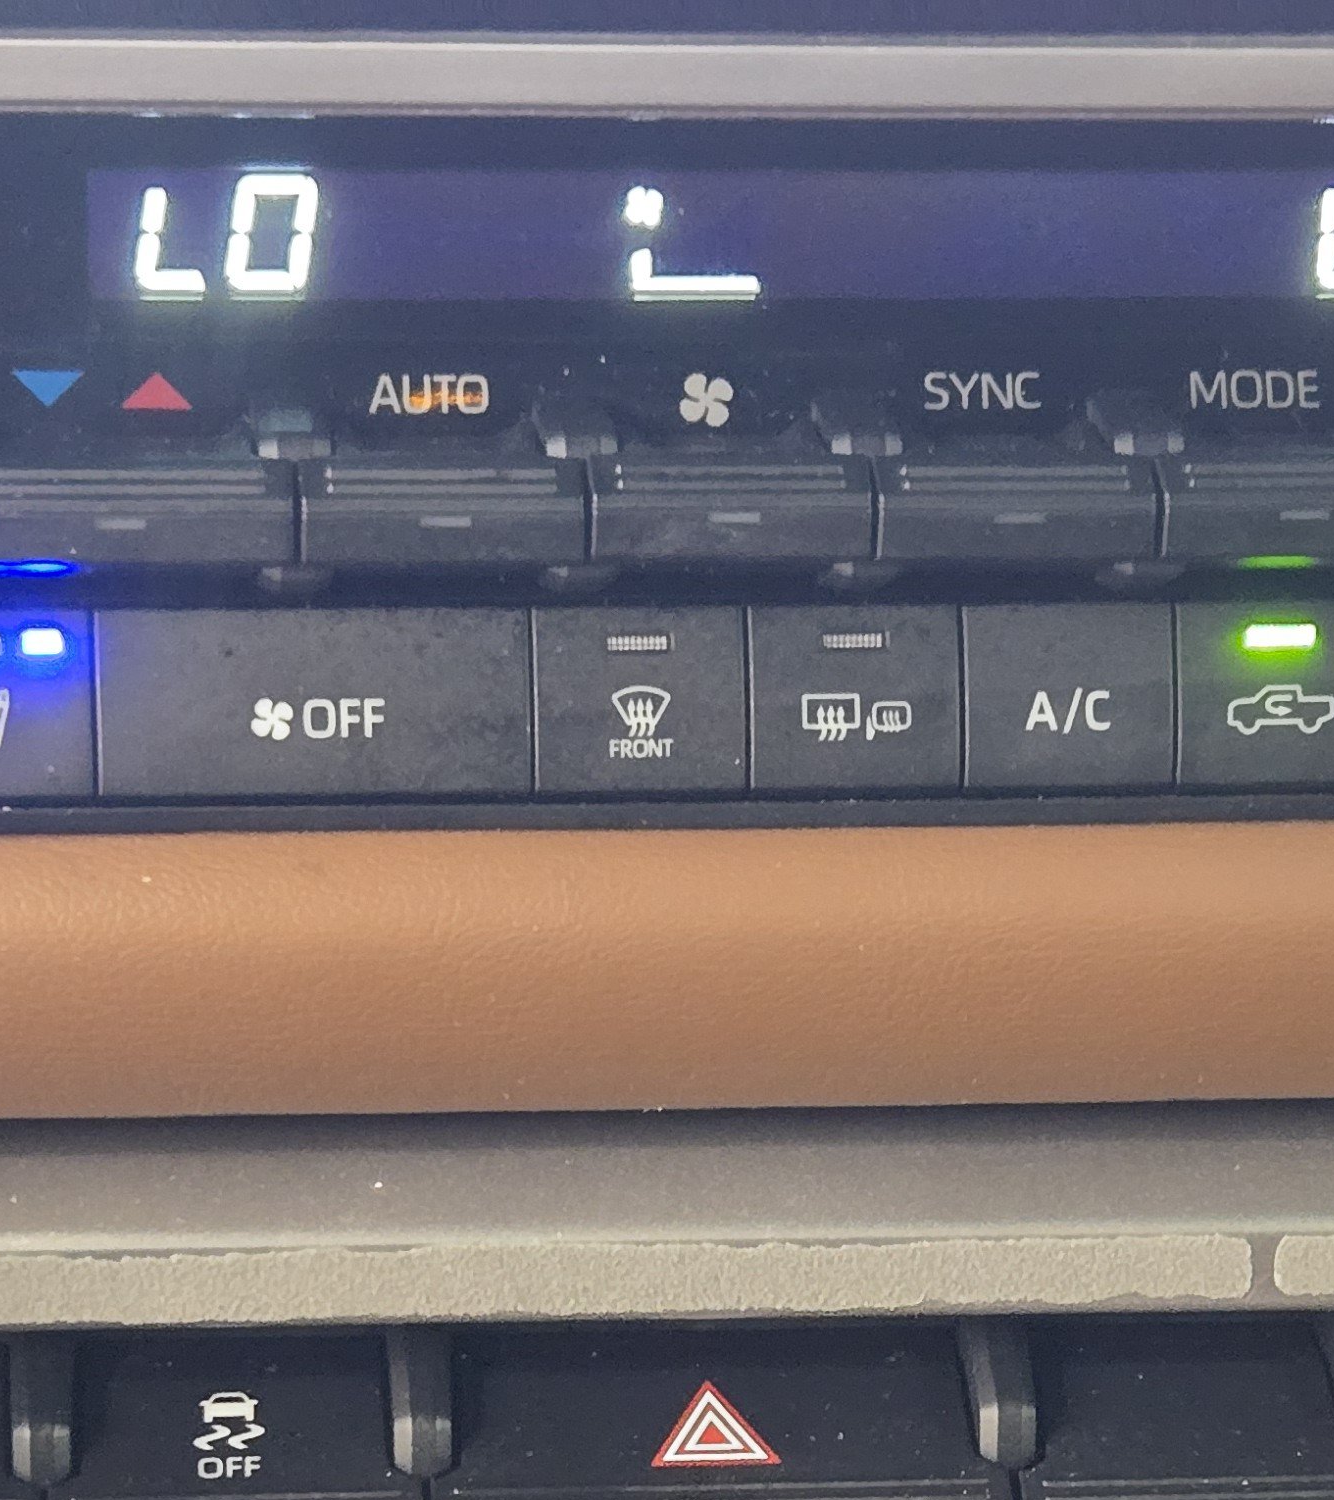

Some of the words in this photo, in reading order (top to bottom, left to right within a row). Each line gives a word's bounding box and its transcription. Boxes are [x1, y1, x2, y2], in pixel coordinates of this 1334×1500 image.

[134, 172, 320, 295] LO
[369, 373, 489, 415] AUTO
[923, 371, 1042, 411] SYNC
[1189, 369, 1321, 410] MODE
[302, 698, 386, 739] OFF
[1025, 687, 1112, 734] A/C
[609, 738, 673, 759] FRONT
[197, 1455, 261, 1479] OFF
